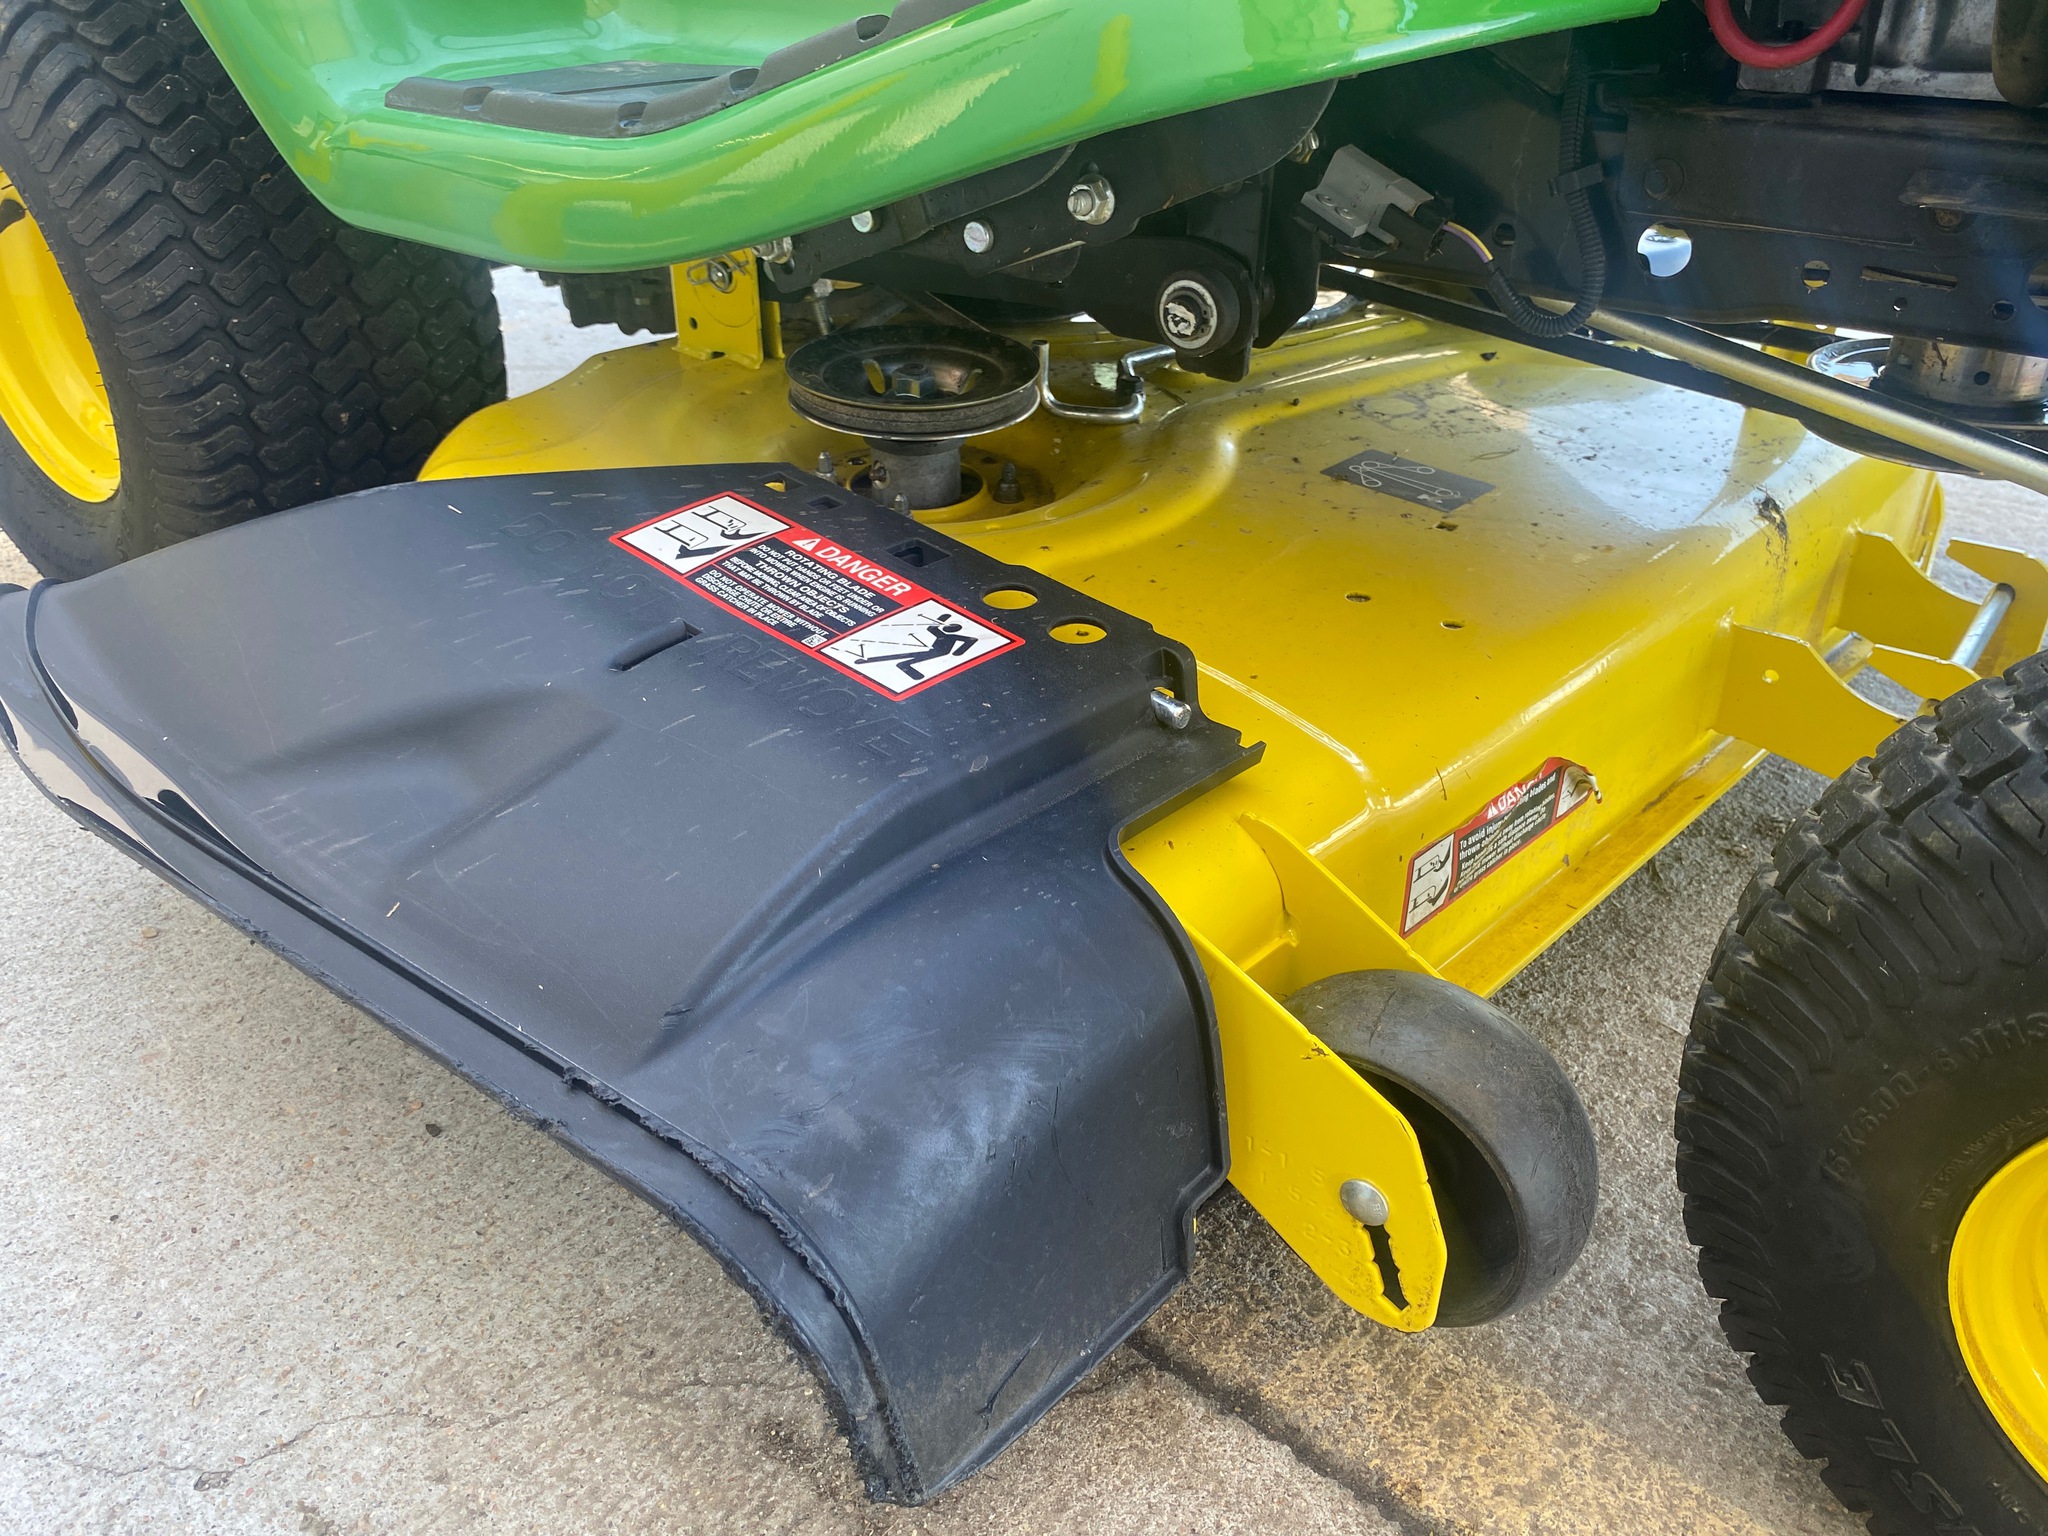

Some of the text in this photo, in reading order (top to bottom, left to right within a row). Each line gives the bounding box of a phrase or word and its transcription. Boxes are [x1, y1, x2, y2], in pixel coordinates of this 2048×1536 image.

[699, 573, 743, 596] DISCHARGE
[736, 594, 765, 609] CHUTE
[719, 561, 742, 572] THAT
[736, 570, 756, 580] MAY
[749, 578, 766, 586] BE
[760, 584, 793, 601] THROWN
[797, 604, 825, 618] BLADE
[727, 556, 757, 572] BEFORE
[777, 584, 803, 597] CLEAR
[797, 595, 820, 606] AREA
[823, 609, 857, 626] OBJECTS
[751, 560, 851, 613] THROWN OBJECTS
[763, 557, 793, 572] MOWER
[788, 570, 813, 582] WHEN
[808, 581, 839, 596] ENGINE
[840, 598, 877, 617] RUNNING
[766, 550, 786, 559] NOT
[780, 557, 798, 566] PUT
[794, 565, 822, 579] HANDS
[817, 577, 833, 585] OR
[827, 583, 850, 594] FEET
[845, 592, 874, 606] UNDER
[870, 605, 885, 613] OR
[782, 549, 877, 598] ROTATING BLADE
[814, 547, 912, 596] DANGER
[692, 577, 720, 592] GRASS
[714, 590, 748, 608] CATCHER
[753, 611, 780, 626] PLACE
[707, 569, 829, 636] DO NOT OPERATE MOWER WITHOUT
[1458, 841, 1480, 861] thrown
[1459, 837, 1467, 850] To
[1468, 827, 1485, 846] avoid
